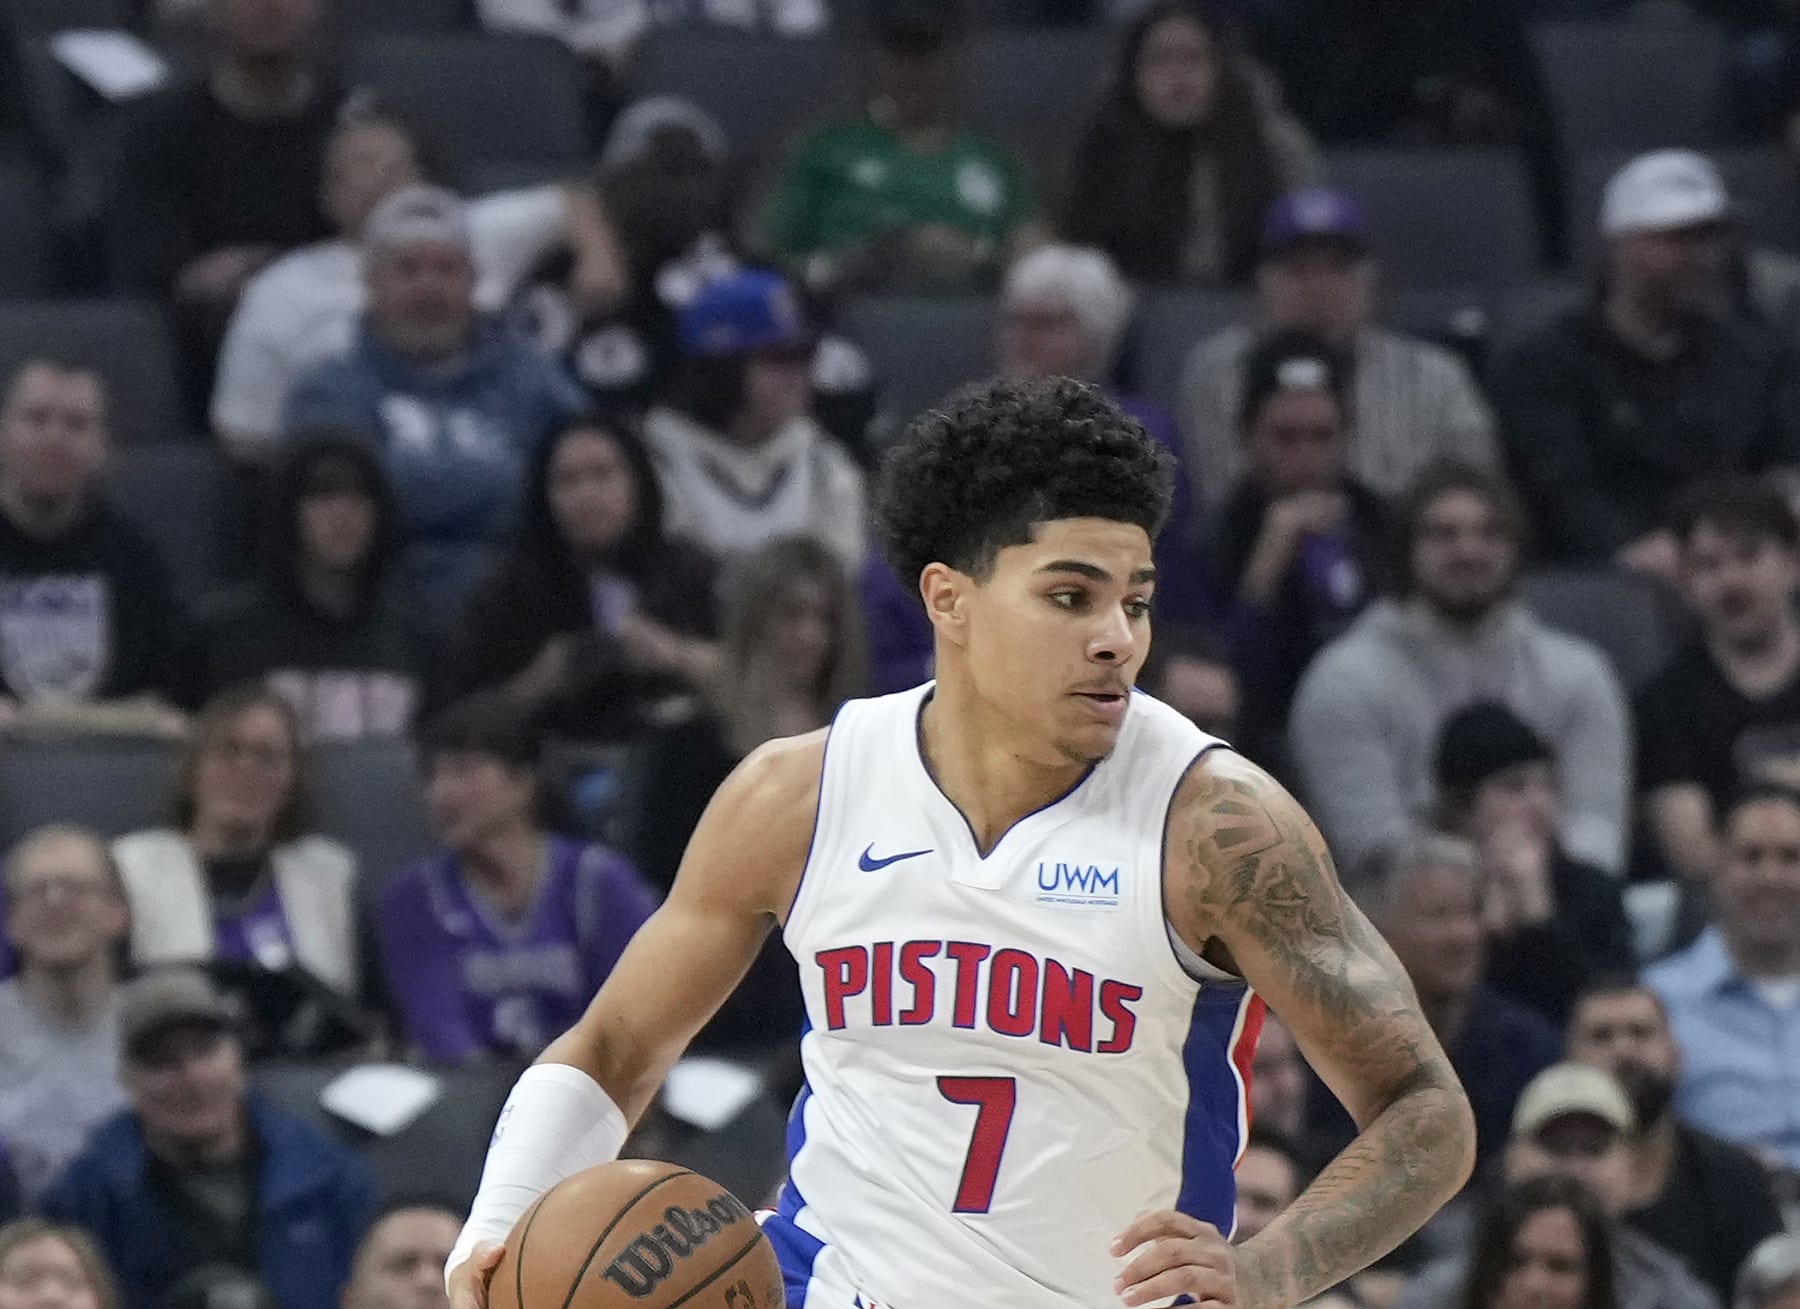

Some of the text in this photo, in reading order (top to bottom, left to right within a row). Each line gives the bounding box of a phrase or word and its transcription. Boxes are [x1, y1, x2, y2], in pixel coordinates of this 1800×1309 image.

[1038, 862, 1118, 895] UWM
[814, 939, 1144, 1054] PISTONS
[935, 1074, 1017, 1214] 7
